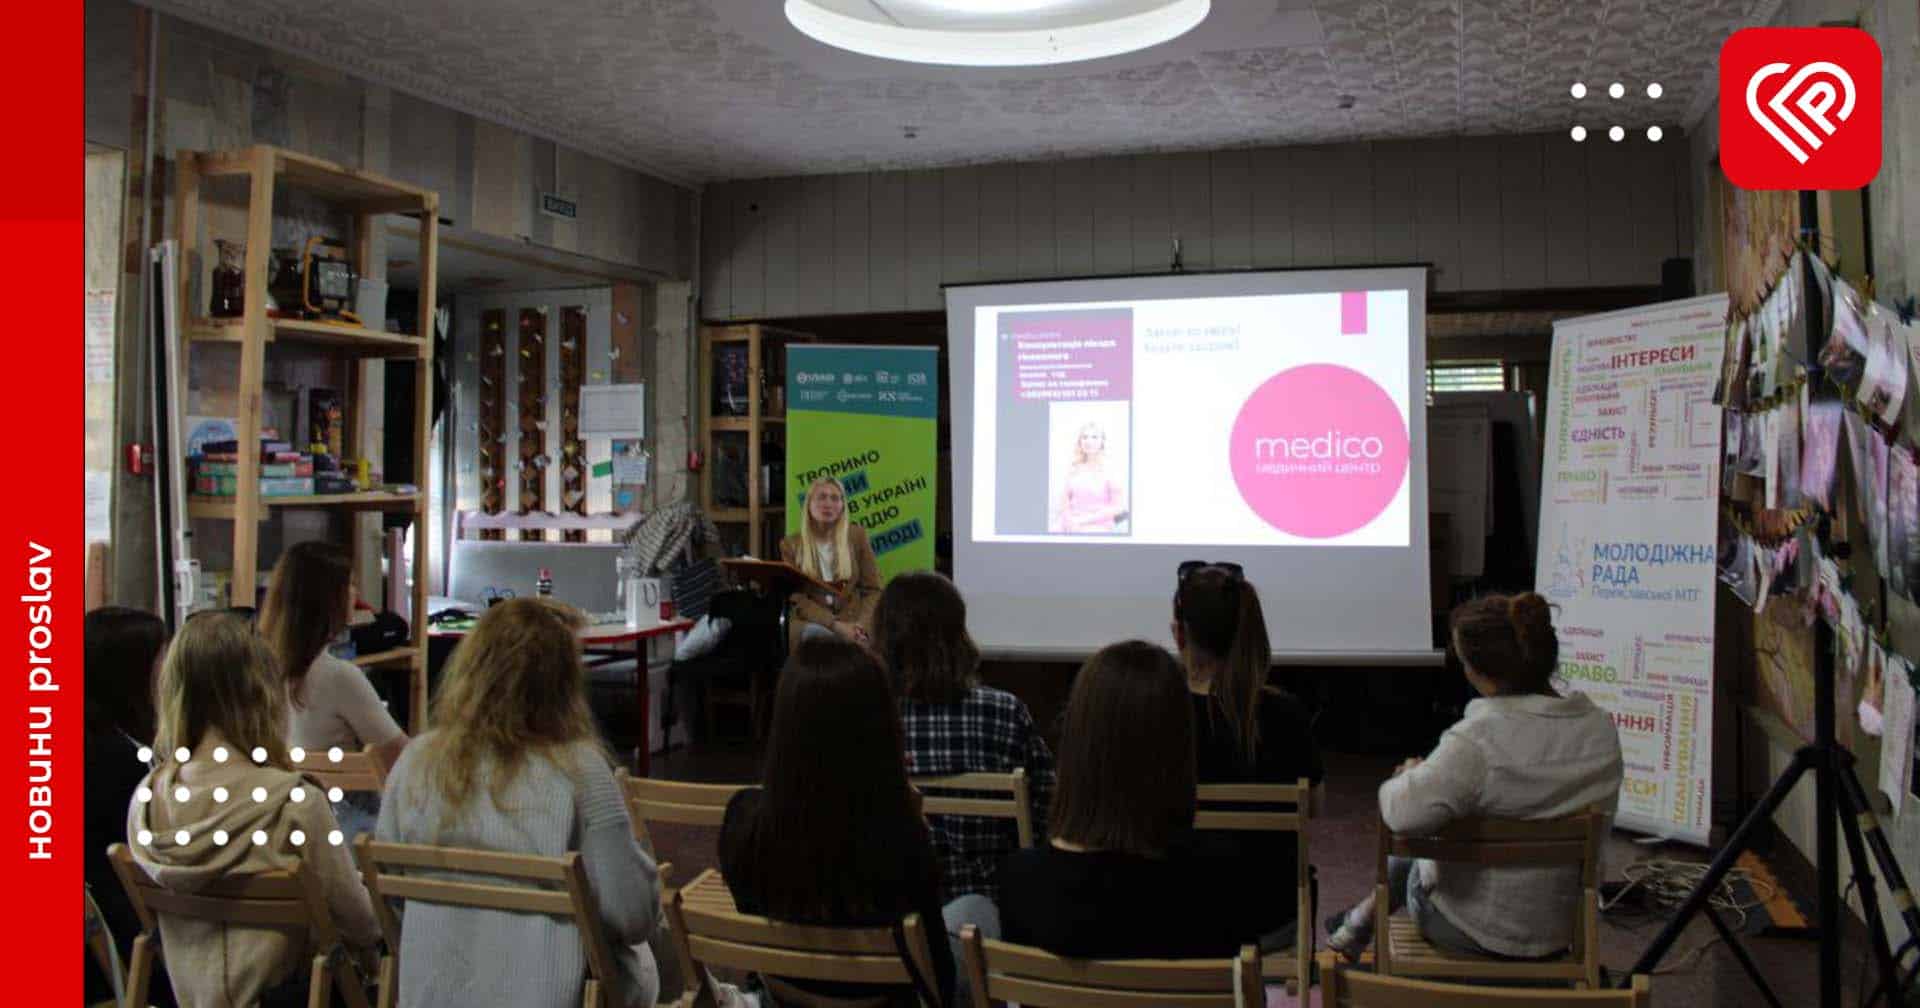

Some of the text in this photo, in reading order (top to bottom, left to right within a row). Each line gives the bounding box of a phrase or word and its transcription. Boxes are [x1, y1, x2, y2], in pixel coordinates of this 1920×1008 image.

[1611, 344, 1695, 369] ІНТЕРЕСИ
[1255, 431, 1383, 459] medico
[1571, 425, 1625, 443] ЄДНІСТЬ
[796, 450, 880, 488] ТВОРИМО
[862, 476, 927, 511] УКРАЇНІ
[1593, 543, 1714, 566] МОЛОДІЖНА
[1592, 564, 1640, 585] РАДА
